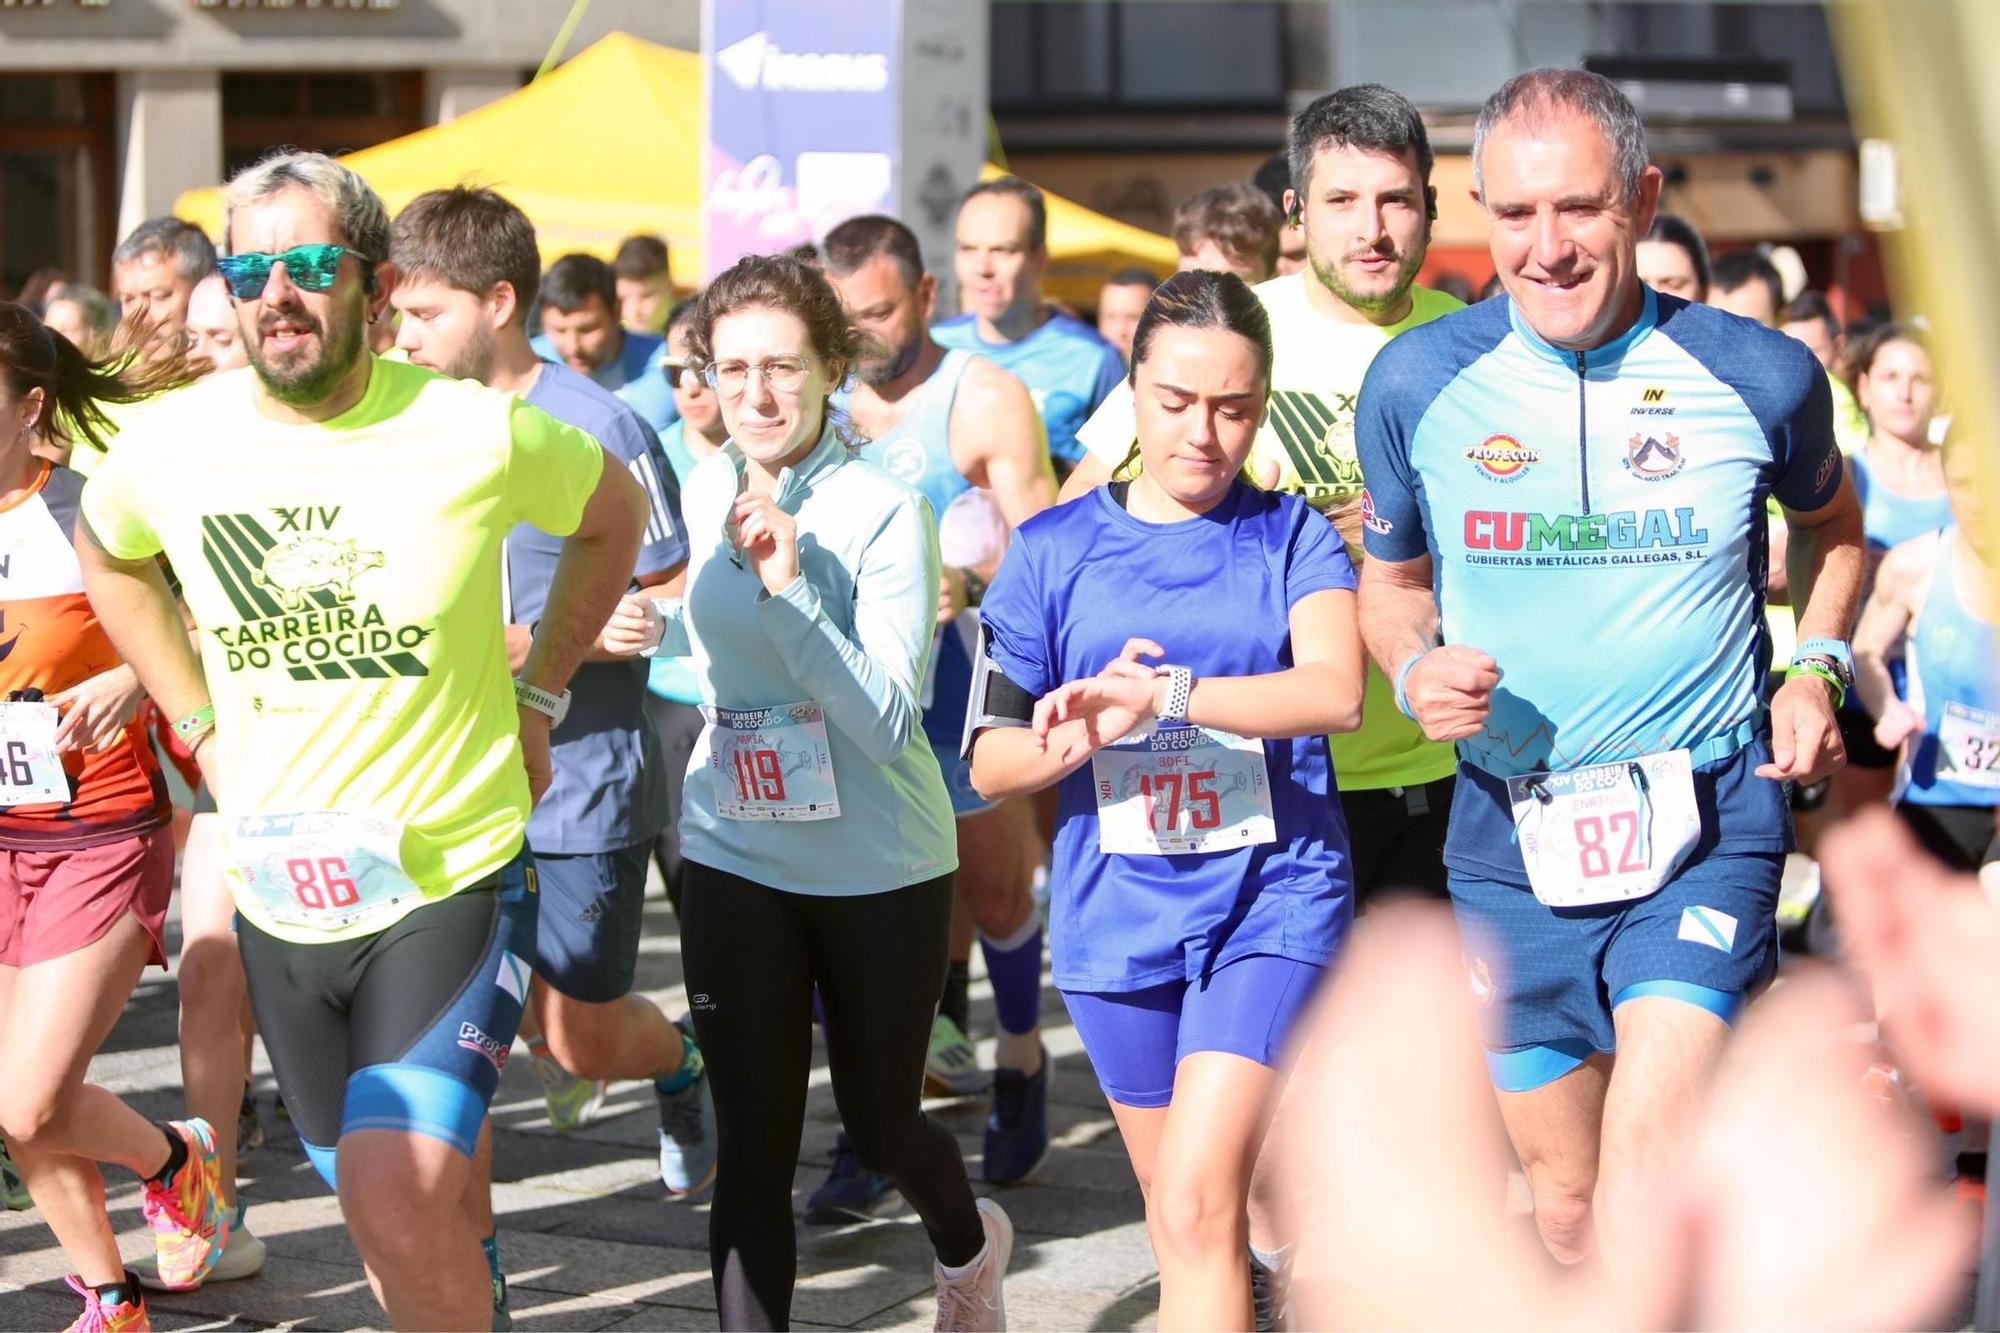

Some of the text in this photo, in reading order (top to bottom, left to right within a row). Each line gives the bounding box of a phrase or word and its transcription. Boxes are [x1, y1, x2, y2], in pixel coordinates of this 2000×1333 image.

[1643, 389, 1664, 401] IN
[1631, 407, 1676, 415] INVERSE
[270, 506, 341, 532] XIV
[1464, 508, 1708, 551] CUMEGAL
[1465, 550, 1708, 566] CUBIERTAS METÁLICAS GALLEGAS, S.L.
[210, 604, 385, 647] CARREIRA
[227, 625, 432, 672] DO COCIDO
[731, 709, 770, 721] CARREIRA
[732, 716, 784, 729] DO COCIDO
[1150, 727, 1206, 742] CARREIRA
[1151, 740, 1169, 751] DO
[1159, 755, 1191, 768] SOFI
[734, 749, 786, 801] 119
[1551, 764, 1628, 788] XIV CARREIRA
[1099, 780, 1112, 800] 10K
[1575, 781, 1594, 793] DO
[1139, 770, 1221, 833] 175
[1574, 811, 1646, 879] 82
[286, 857, 361, 909] 86
